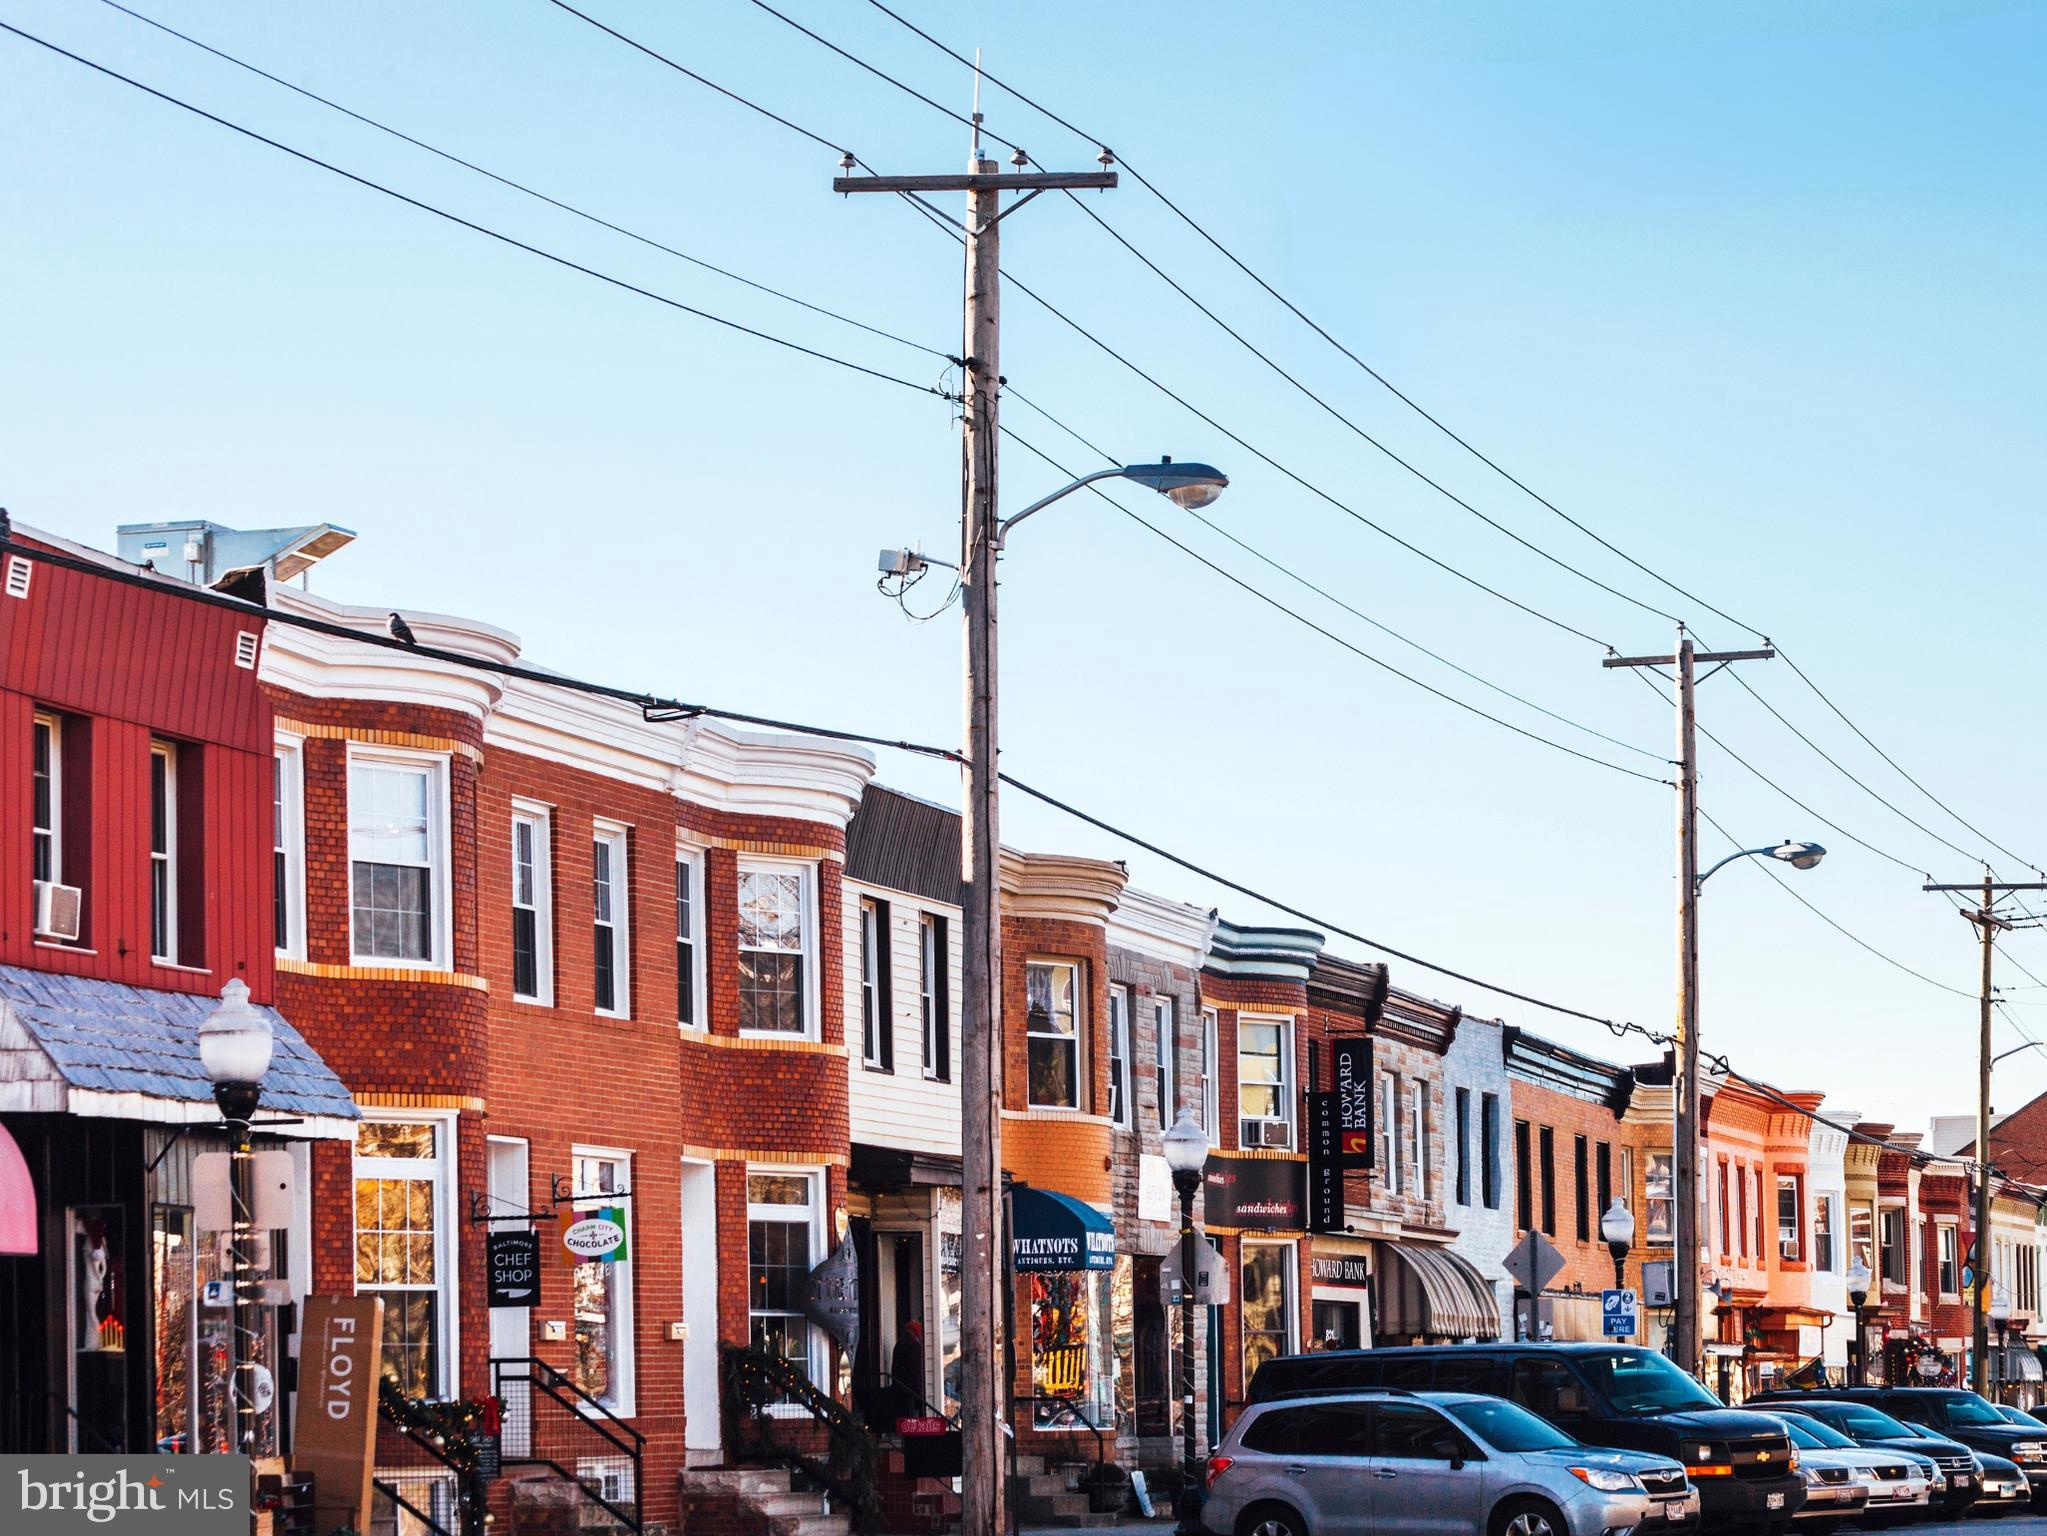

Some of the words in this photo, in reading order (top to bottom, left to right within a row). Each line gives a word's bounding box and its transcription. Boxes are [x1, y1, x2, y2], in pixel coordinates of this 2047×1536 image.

[1340, 1052, 1352, 1129] HOWARD
[1354, 1080, 1366, 1129] BANK
[1321, 1100, 1330, 1155] common
[1323, 1168, 1331, 1224] ground
[1236, 1202, 1287, 1214] sandwiches
[598, 1224, 614, 1232] CITY
[493, 1239, 533, 1251] BALTIMORE
[567, 1234, 620, 1249] CHOCOLATE
[494, 1252, 532, 1267] CHEF
[1017, 1257, 1055, 1265] ANTIQUES,
[1058, 1256, 1075, 1265] ETC.
[494, 1269, 532, 1283] SHOP
[1344, 1261, 1365, 1280] BANK
[1610, 1317, 1627, 1325] PAY
[1608, 1325, 1631, 1333] ERE
[327, 1317, 356, 1420] FLOYD
